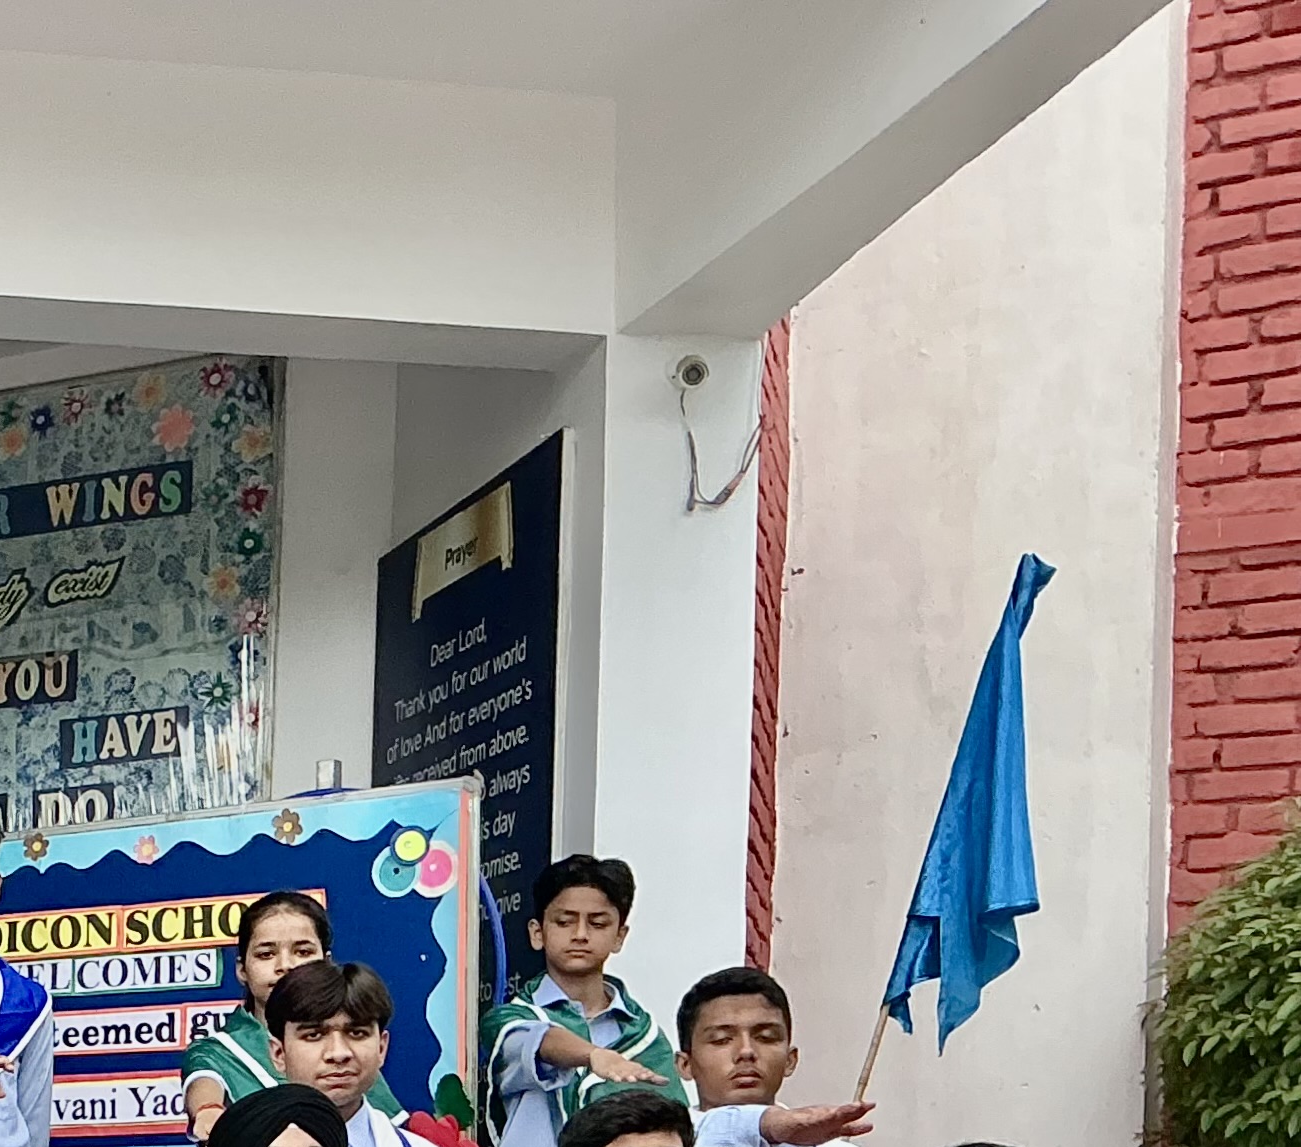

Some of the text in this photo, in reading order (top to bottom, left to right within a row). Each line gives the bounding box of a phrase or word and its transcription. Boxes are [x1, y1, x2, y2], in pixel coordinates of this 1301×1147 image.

[46, 470, 183, 528] WINGS
[444, 536, 479, 572] Prayer
[50, 567, 113, 600] exist
[430, 617, 487, 667] Dear Lord,
[394, 636, 527, 723] Thank you for our world
[71, 709, 177, 764] HAVE
[386, 678, 532, 764] of love And for everyone's
[459, 744, 486, 768] from
[489, 725, 529, 758] above.
[488, 764, 530, 797] always
[492, 810, 516, 838] day
[125, 900, 248, 946] SCHO
[24, 952, 211, 990] ELCOMES
[52, 1011, 177, 1048] teemed
[53, 1085, 187, 1121] vani Yad
